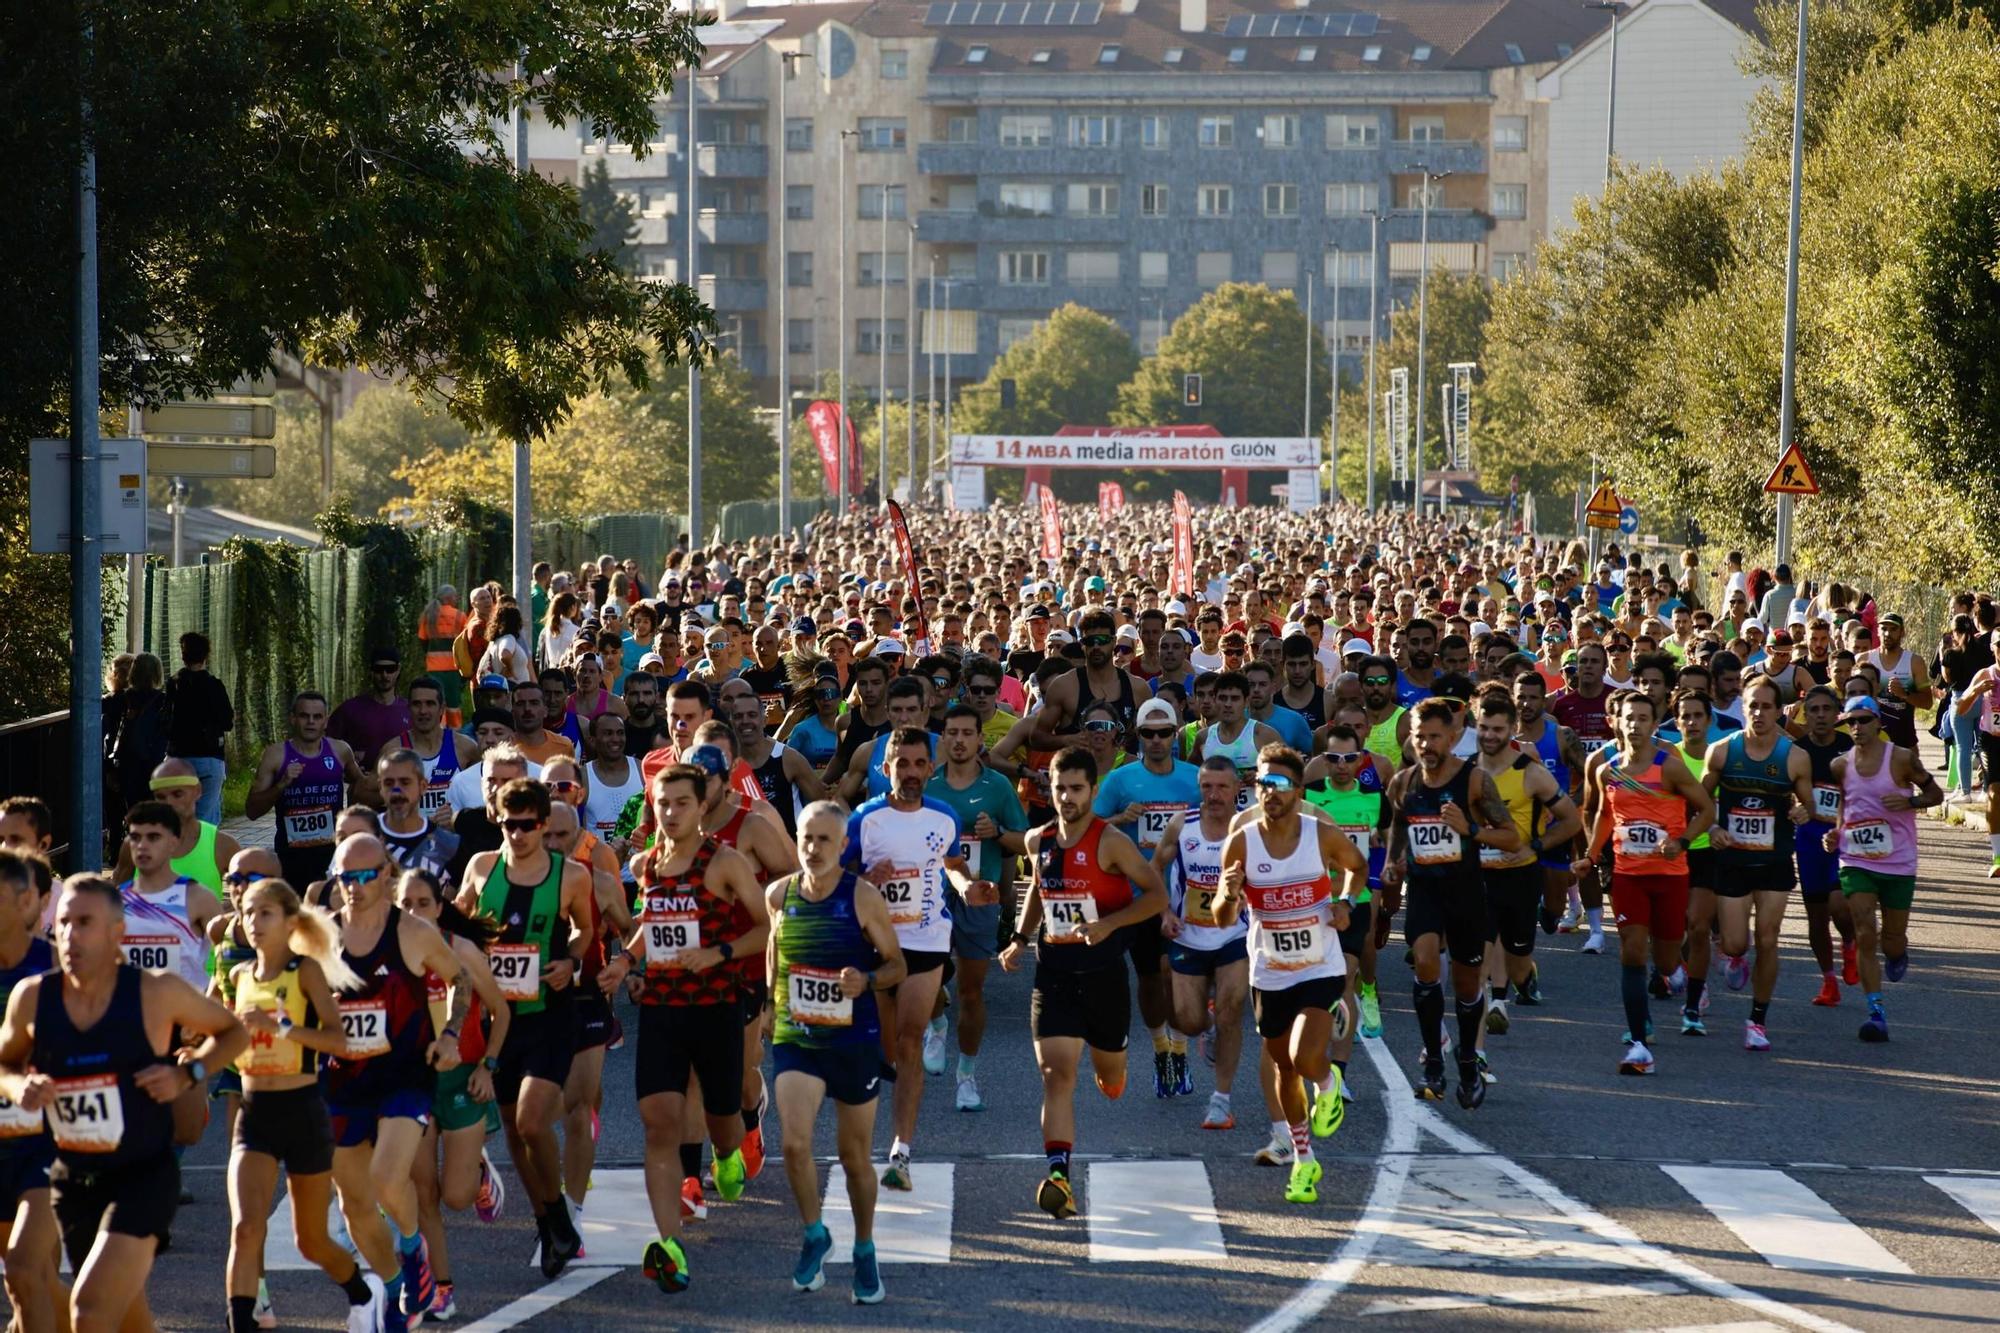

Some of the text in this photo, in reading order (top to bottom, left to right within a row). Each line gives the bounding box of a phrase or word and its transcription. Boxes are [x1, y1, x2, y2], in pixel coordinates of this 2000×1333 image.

[995, 440, 1022, 458] 14
[1026, 445, 1071, 458] MBA
[1076, 441, 1134, 460] media
[1138, 442, 1224, 460] maratón
[1231, 442, 1276, 457] GIJÓN
[304, 785, 319, 794] DE
[291, 814, 328, 833] 1280
[1735, 818, 1767, 834] 2191
[1413, 826, 1453, 845] 1204
[1628, 827, 1657, 843] 578
[1852, 827, 1884, 845] 1124
[645, 895, 699, 912] KENYA
[920, 859, 937, 929] eurofins
[1263, 886, 1314, 903] ELCHE
[1053, 903, 1086, 924] 413
[652, 925, 687, 948] 969
[1272, 929, 1311, 952] 1519
[129, 947, 168, 969] 960
[796, 978, 843, 1004] 1389
[341, 1014, 377, 1038] 212
[54, 1092, 109, 1124] 1341
